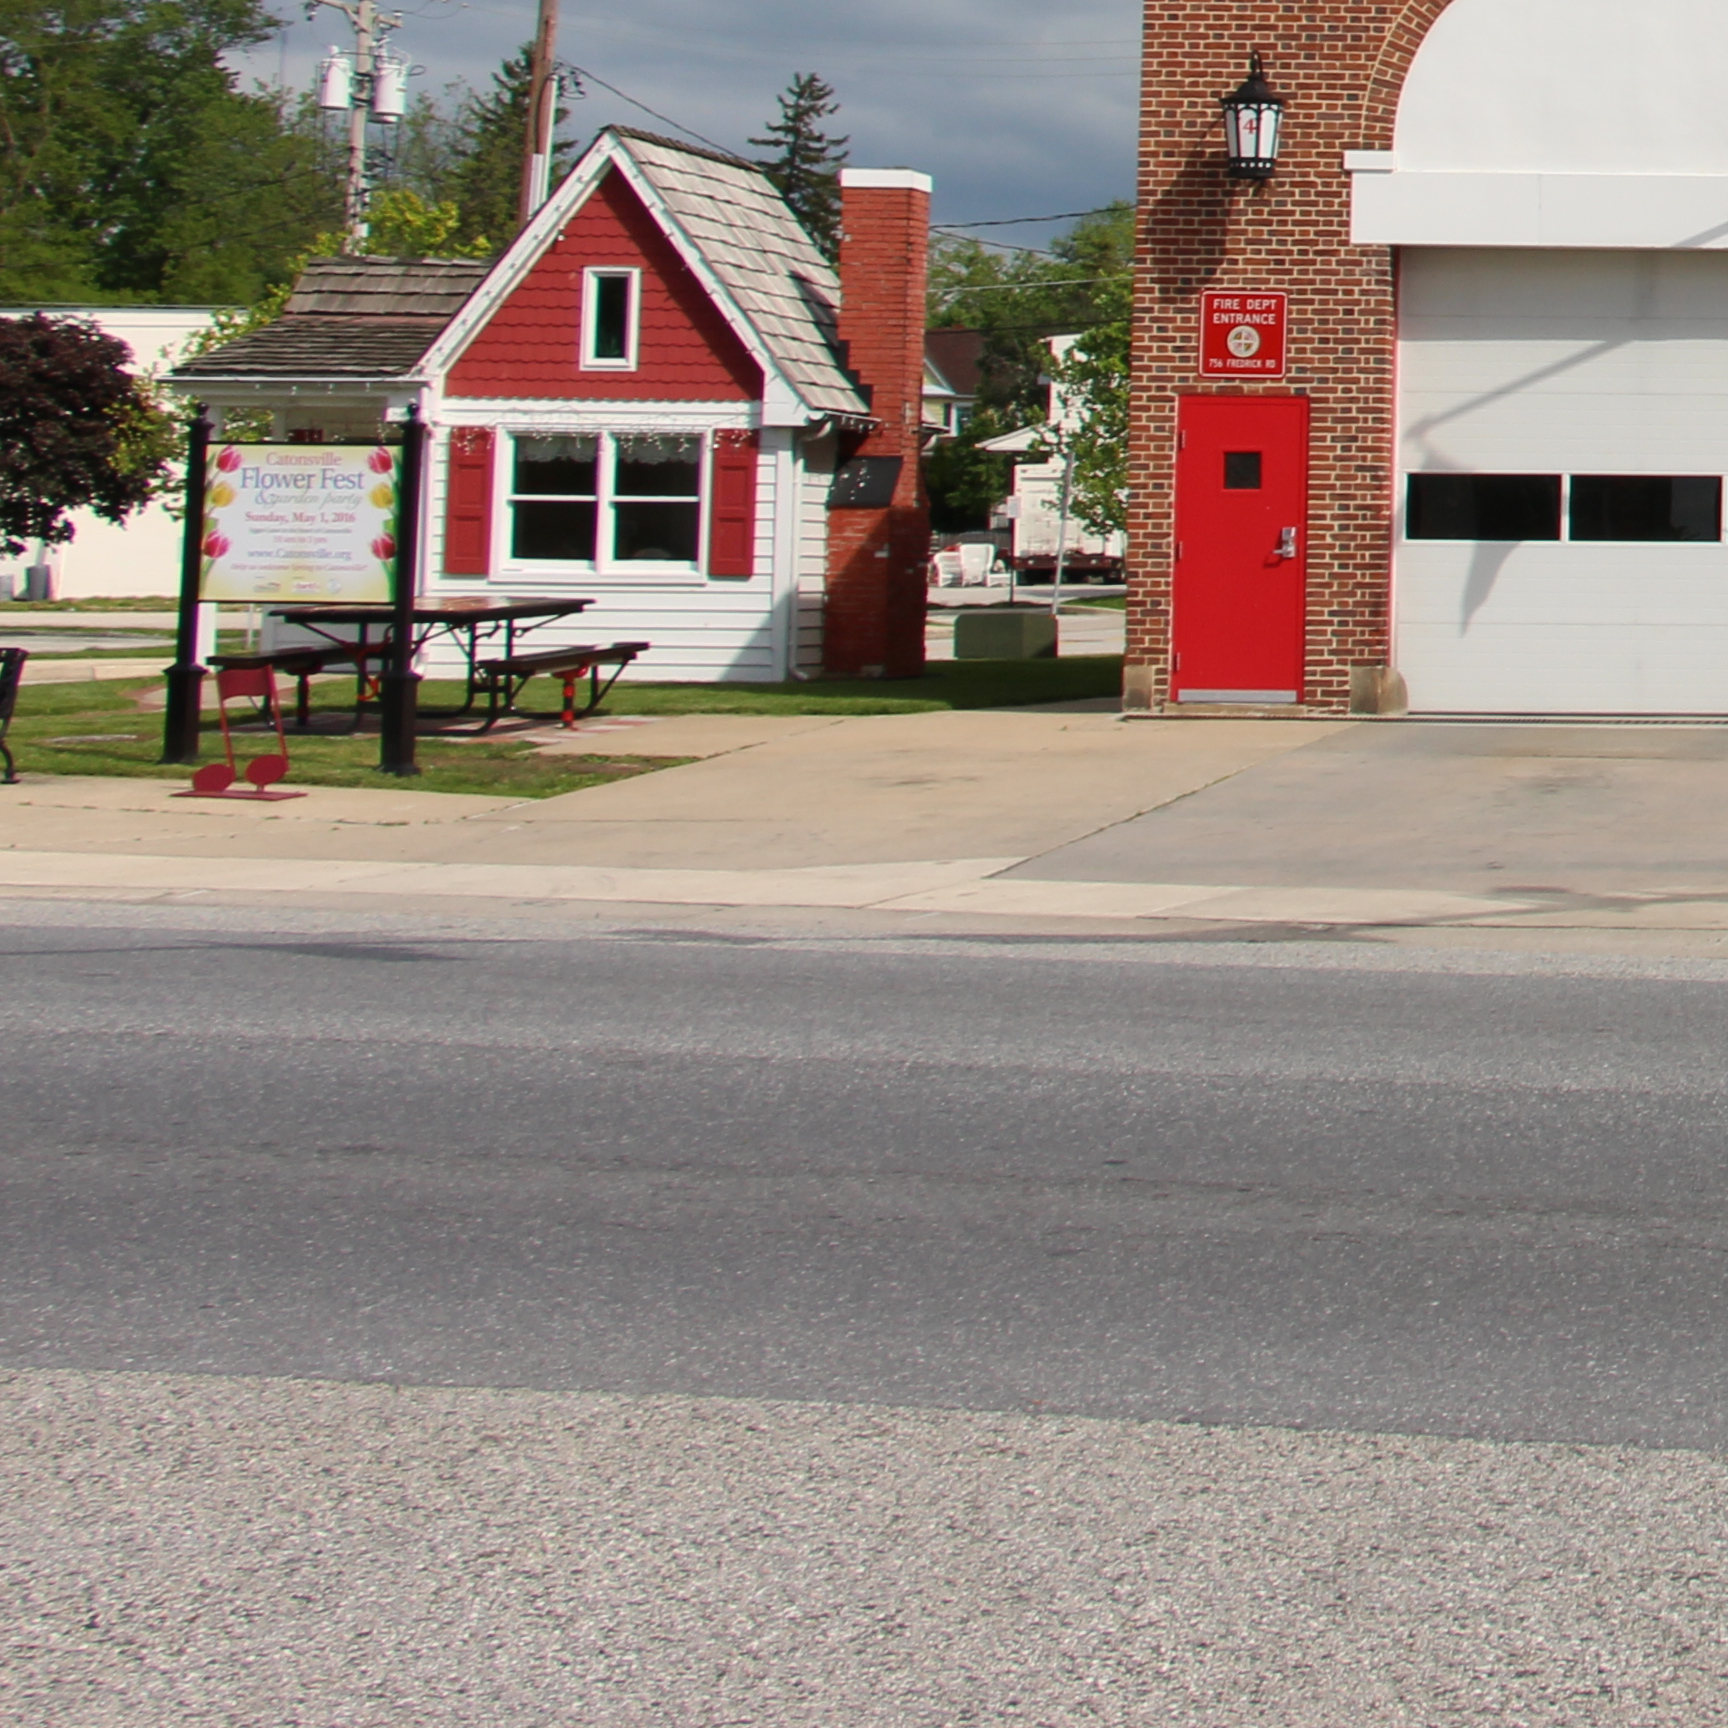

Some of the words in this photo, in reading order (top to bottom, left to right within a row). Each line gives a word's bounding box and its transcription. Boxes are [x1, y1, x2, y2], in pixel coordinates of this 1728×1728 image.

[1242, 118, 1258, 134] 4
[1213, 298, 1240, 310] FIRE
[1246, 298, 1277, 310] DEPT
[1212, 312, 1276, 325] ENTRANCE
[1265, 359, 1276, 369] RD
[266, 452, 342, 466] Catonsville
[240, 466, 317, 490] Flower
[320, 468, 366, 490] Fest
[263, 488, 319, 509] garden
[319, 491, 363, 510] party
[244, 511, 289, 525] Sunday,
[292, 512, 317, 525] May
[331, 512, 357, 523] 2016
